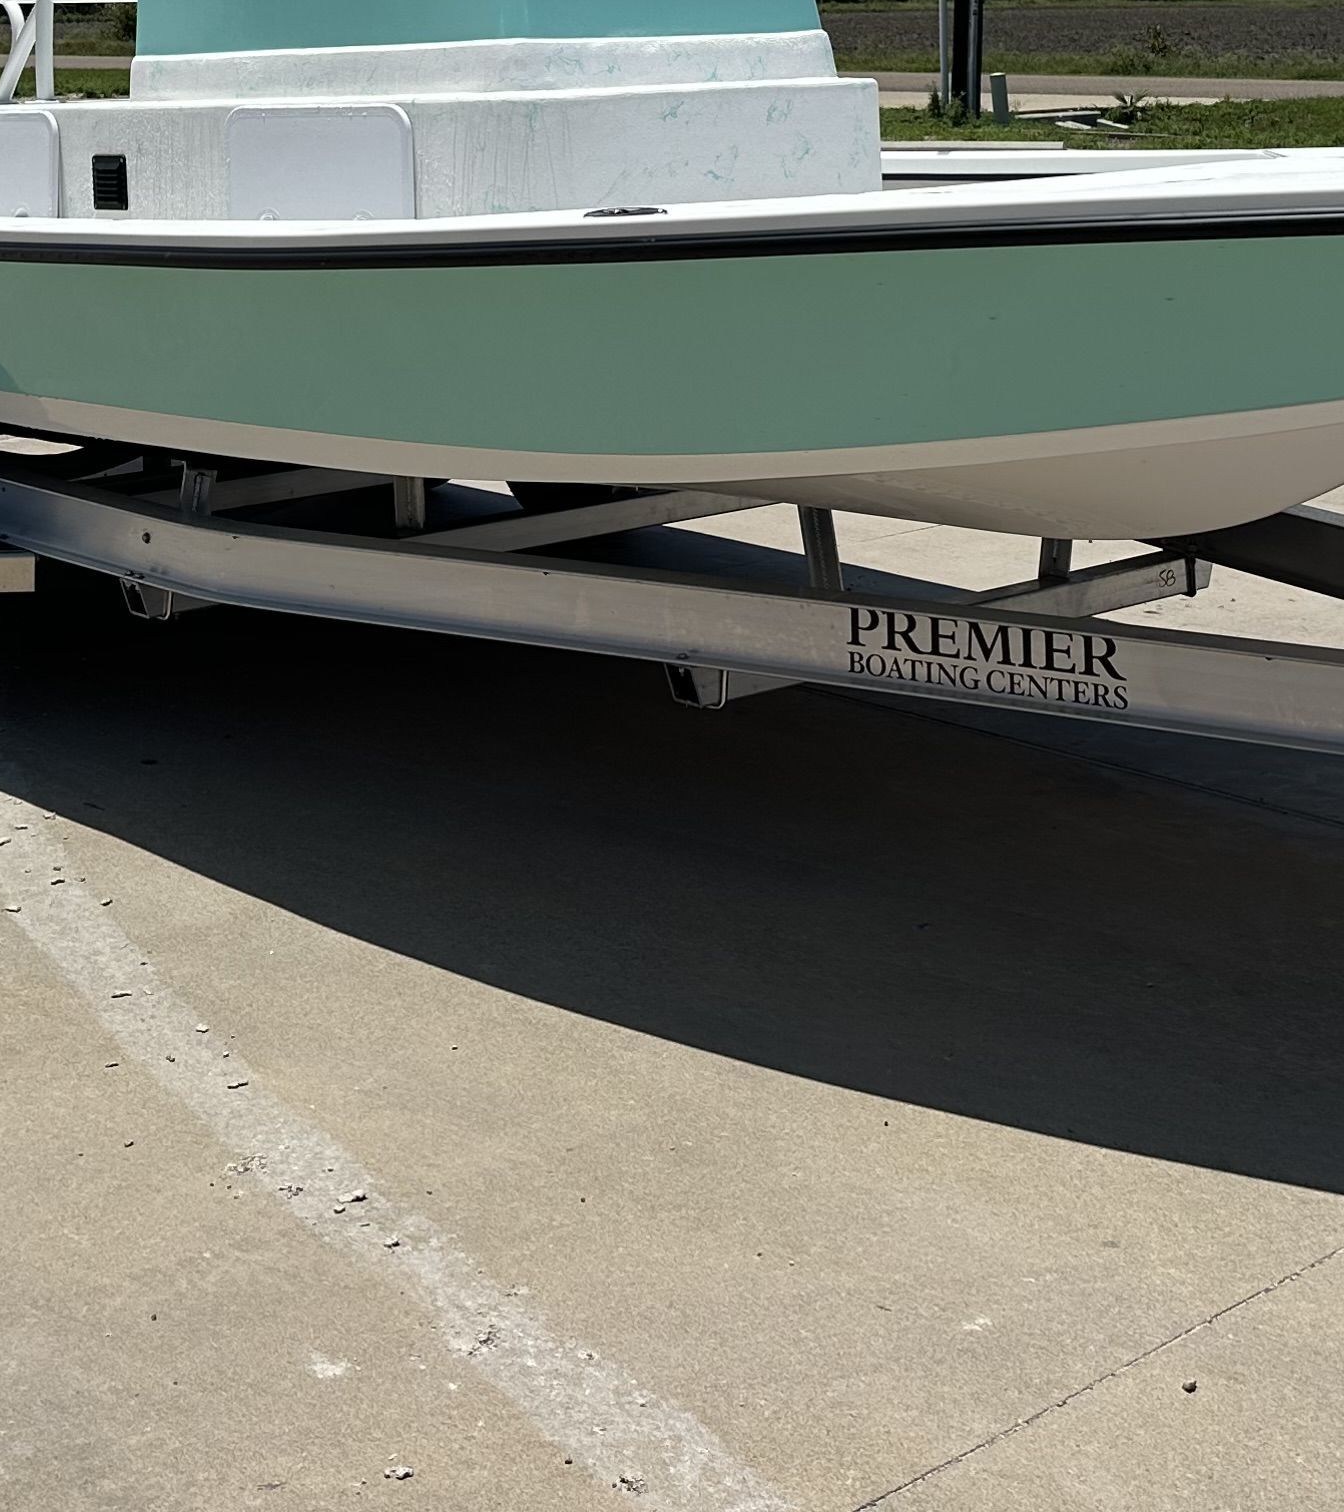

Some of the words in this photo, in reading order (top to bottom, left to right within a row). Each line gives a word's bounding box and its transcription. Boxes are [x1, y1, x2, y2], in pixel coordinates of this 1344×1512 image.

[847, 607, 1127, 681] PREMIER
[847, 650, 981, 690] BOATING
[986, 669, 1129, 710] CENTERS
